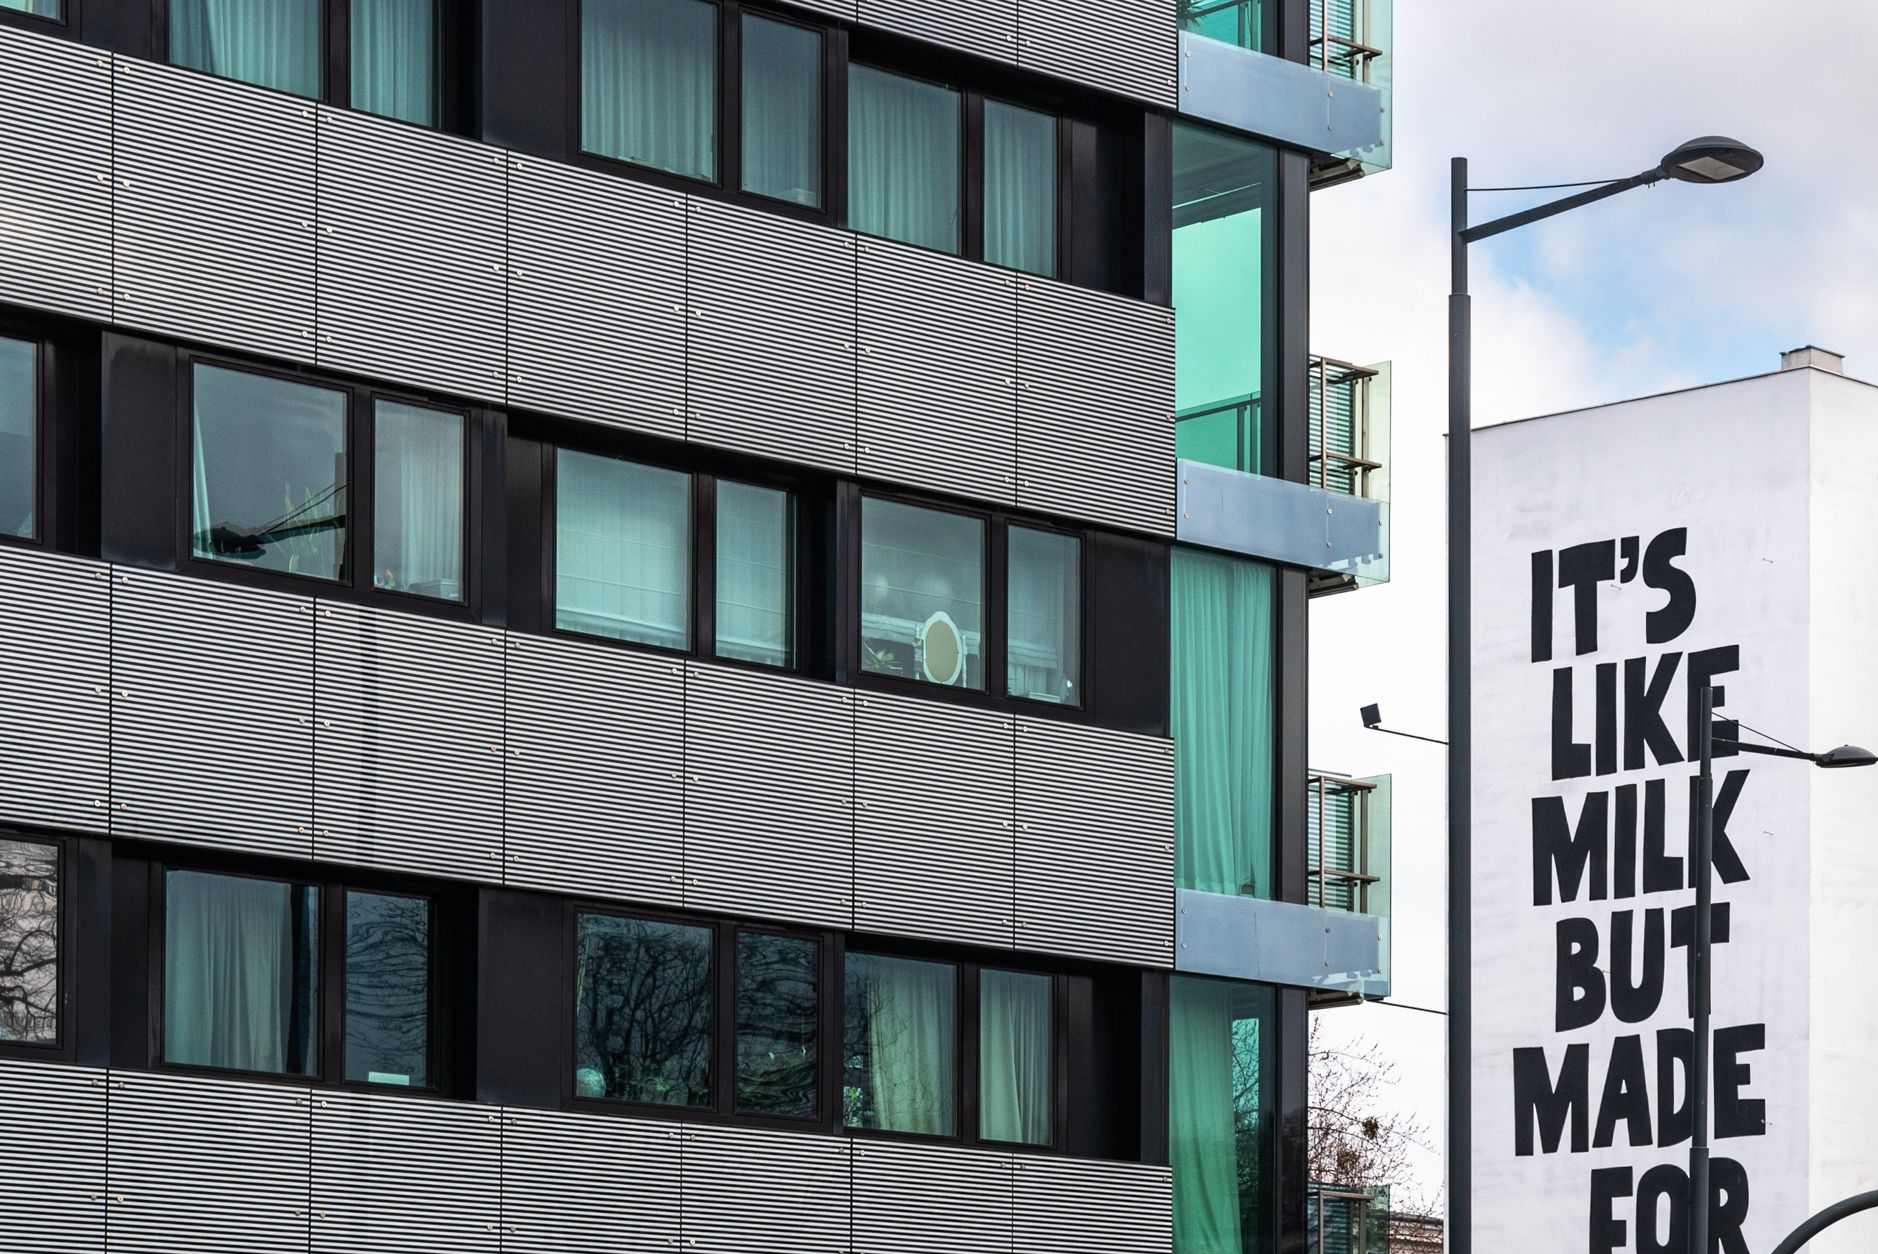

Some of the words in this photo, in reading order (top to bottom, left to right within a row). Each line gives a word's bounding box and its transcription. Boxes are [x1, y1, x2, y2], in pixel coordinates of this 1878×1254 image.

[1531, 527, 1697, 663] IT'S
[1551, 644, 1739, 781] LIKE
[1531, 769, 1751, 906] MILK
[1555, 903, 1730, 1033] BUT
[1513, 1023, 1766, 1156] MADE
